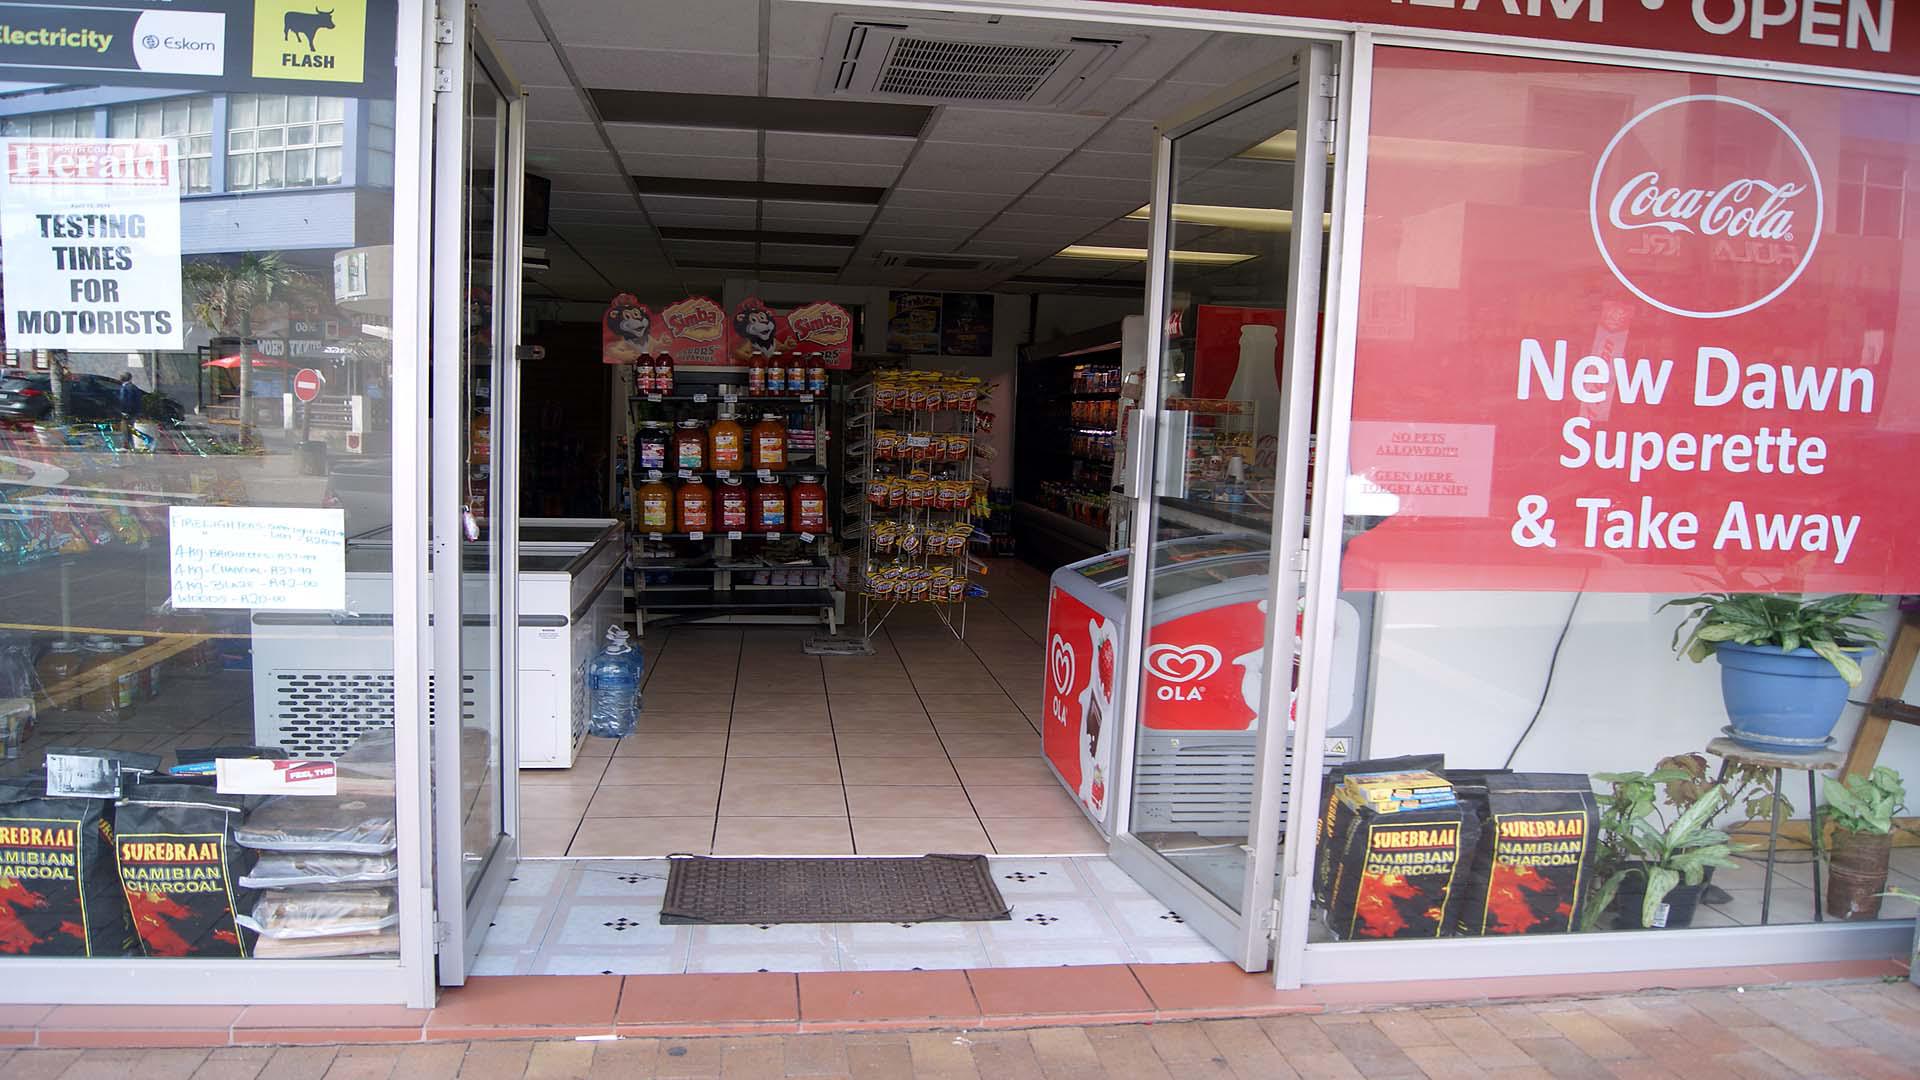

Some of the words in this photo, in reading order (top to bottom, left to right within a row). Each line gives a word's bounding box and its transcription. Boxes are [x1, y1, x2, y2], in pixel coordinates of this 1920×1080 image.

[1691, 0, 1894, 52] OPEN
[164, 37, 216, 52] Eskom
[282, 53, 335, 69] FLASH
[17, 146, 163, 178] Herald
[1608, 171, 1806, 240] Coca-Cola
[36, 214, 146, 239] TESTING
[52, 245, 133, 271] TIMES
[70, 279, 119, 302] FOR
[17, 310, 173, 335] MOTORISTS
[669, 308, 717, 333] Simba
[794, 311, 842, 337] Simba
[1517, 338, 1674, 405] New
[1694, 346, 1876, 414] Dawn
[1392, 432, 1410, 443] NO
[1415, 432, 1447, 443] PETS
[1560, 417, 1828, 482] Superette
[1375, 471, 1410, 482] GEEN
[1414, 472, 1455, 483] DIERE
[1511, 495, 1556, 548] &
[1576, 497, 1698, 549] Take
[1713, 501, 1861, 565] Away
[1157, 686, 1202, 701] OLA
[1053, 696, 1067, 727] OLA
[290, 770, 313, 779] FEEL
[314, 767, 334, 777] THE
[0, 826, 74, 848] REBRAAI
[1499, 819, 1583, 838] SUREBRAAI
[1371, 829, 1455, 848] SUREBRAAI
[1498, 840, 1581, 854] NAMIBIAN
[0, 851, 76, 866] MIBIAN
[121, 842, 219, 861] SUREBRAAI
[1369, 851, 1455, 864] NAMIBIAN
[1498, 853, 1578, 866] CHARCOAL
[0, 865, 76, 880] ARCOAL
[122, 866, 222, 881] NAMIBIAN
[1367, 863, 1451, 876] CHARCOAL
[126, 880, 224, 894] CHARCOAL
